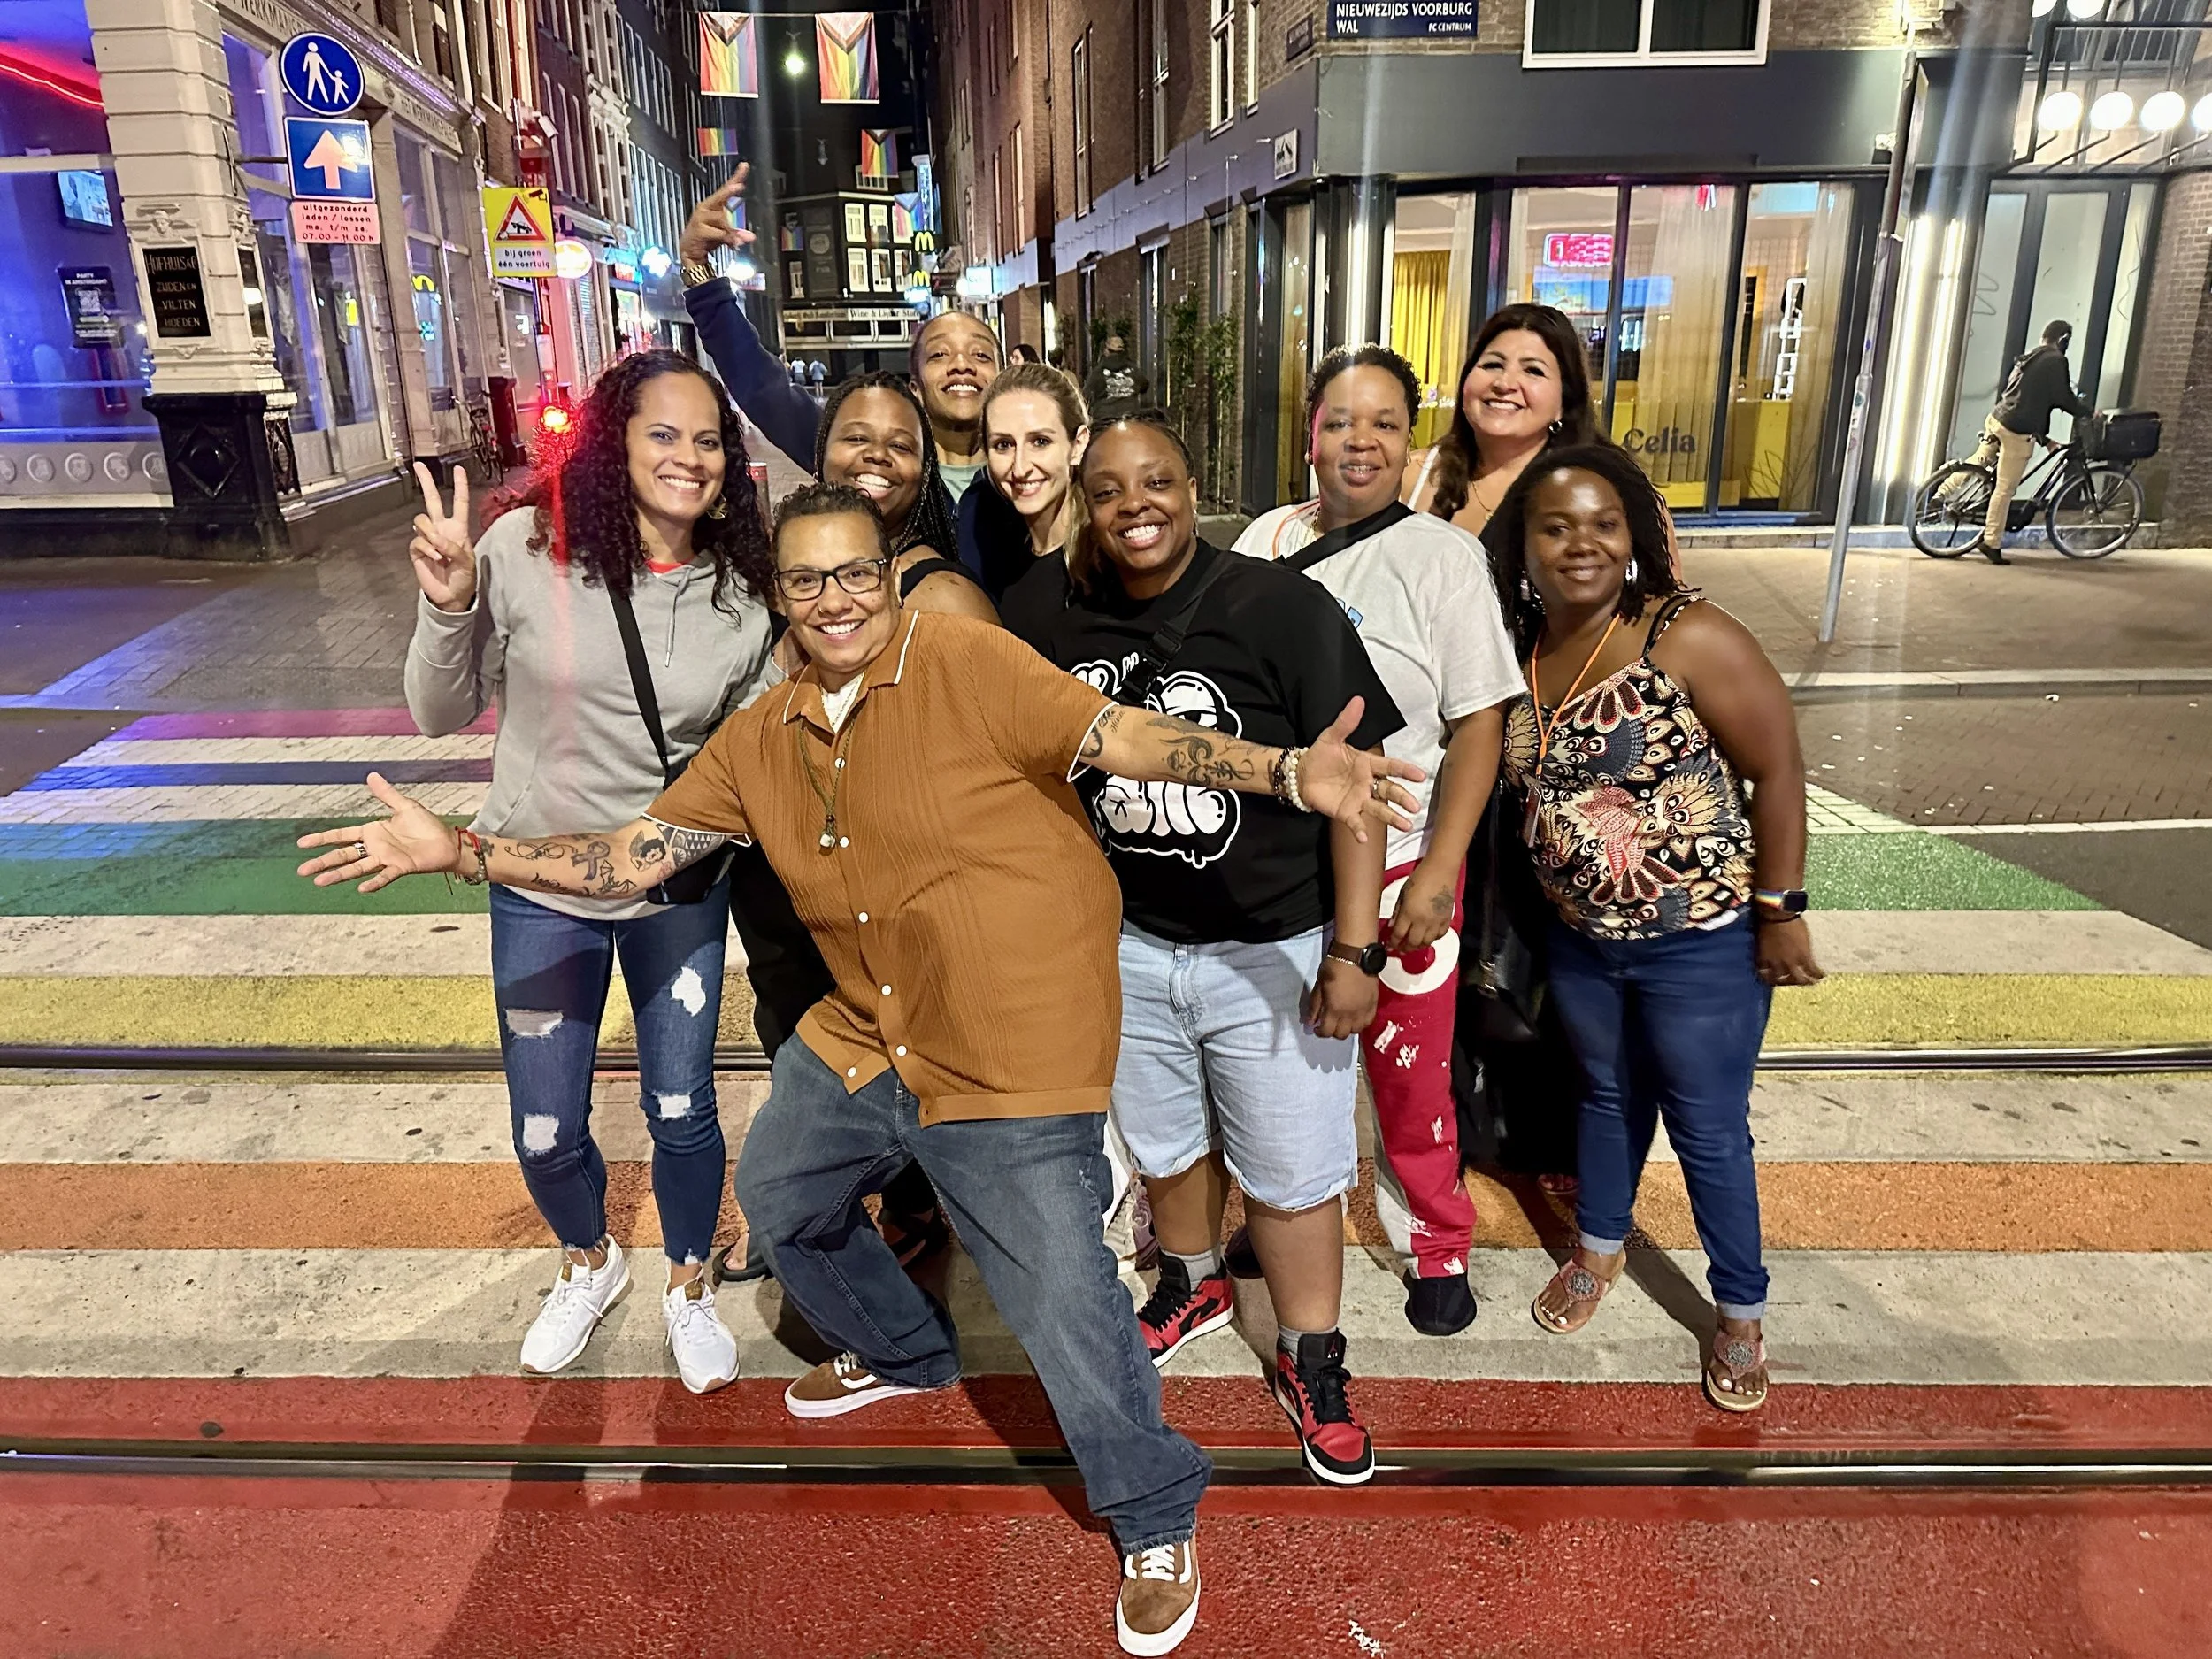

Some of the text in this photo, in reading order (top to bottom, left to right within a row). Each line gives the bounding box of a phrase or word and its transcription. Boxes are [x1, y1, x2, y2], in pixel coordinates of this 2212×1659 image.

[1336, 2, 1472, 19] NIEUWEZIJDS VOORBURG
[1336, 19, 1358, 33] WAL
[1438, 22, 1471, 32] CENTRUM
[303, 204, 368, 213] uitgezonderd
[504, 250, 542, 259] bij groen
[515, 260, 550, 270] voertuig
[161, 299, 196, 311] VILTEN
[849, 309, 869, 318] Wine
[164, 317, 201, 327] HOEDEN
[1624, 426, 1696, 454] Celia
